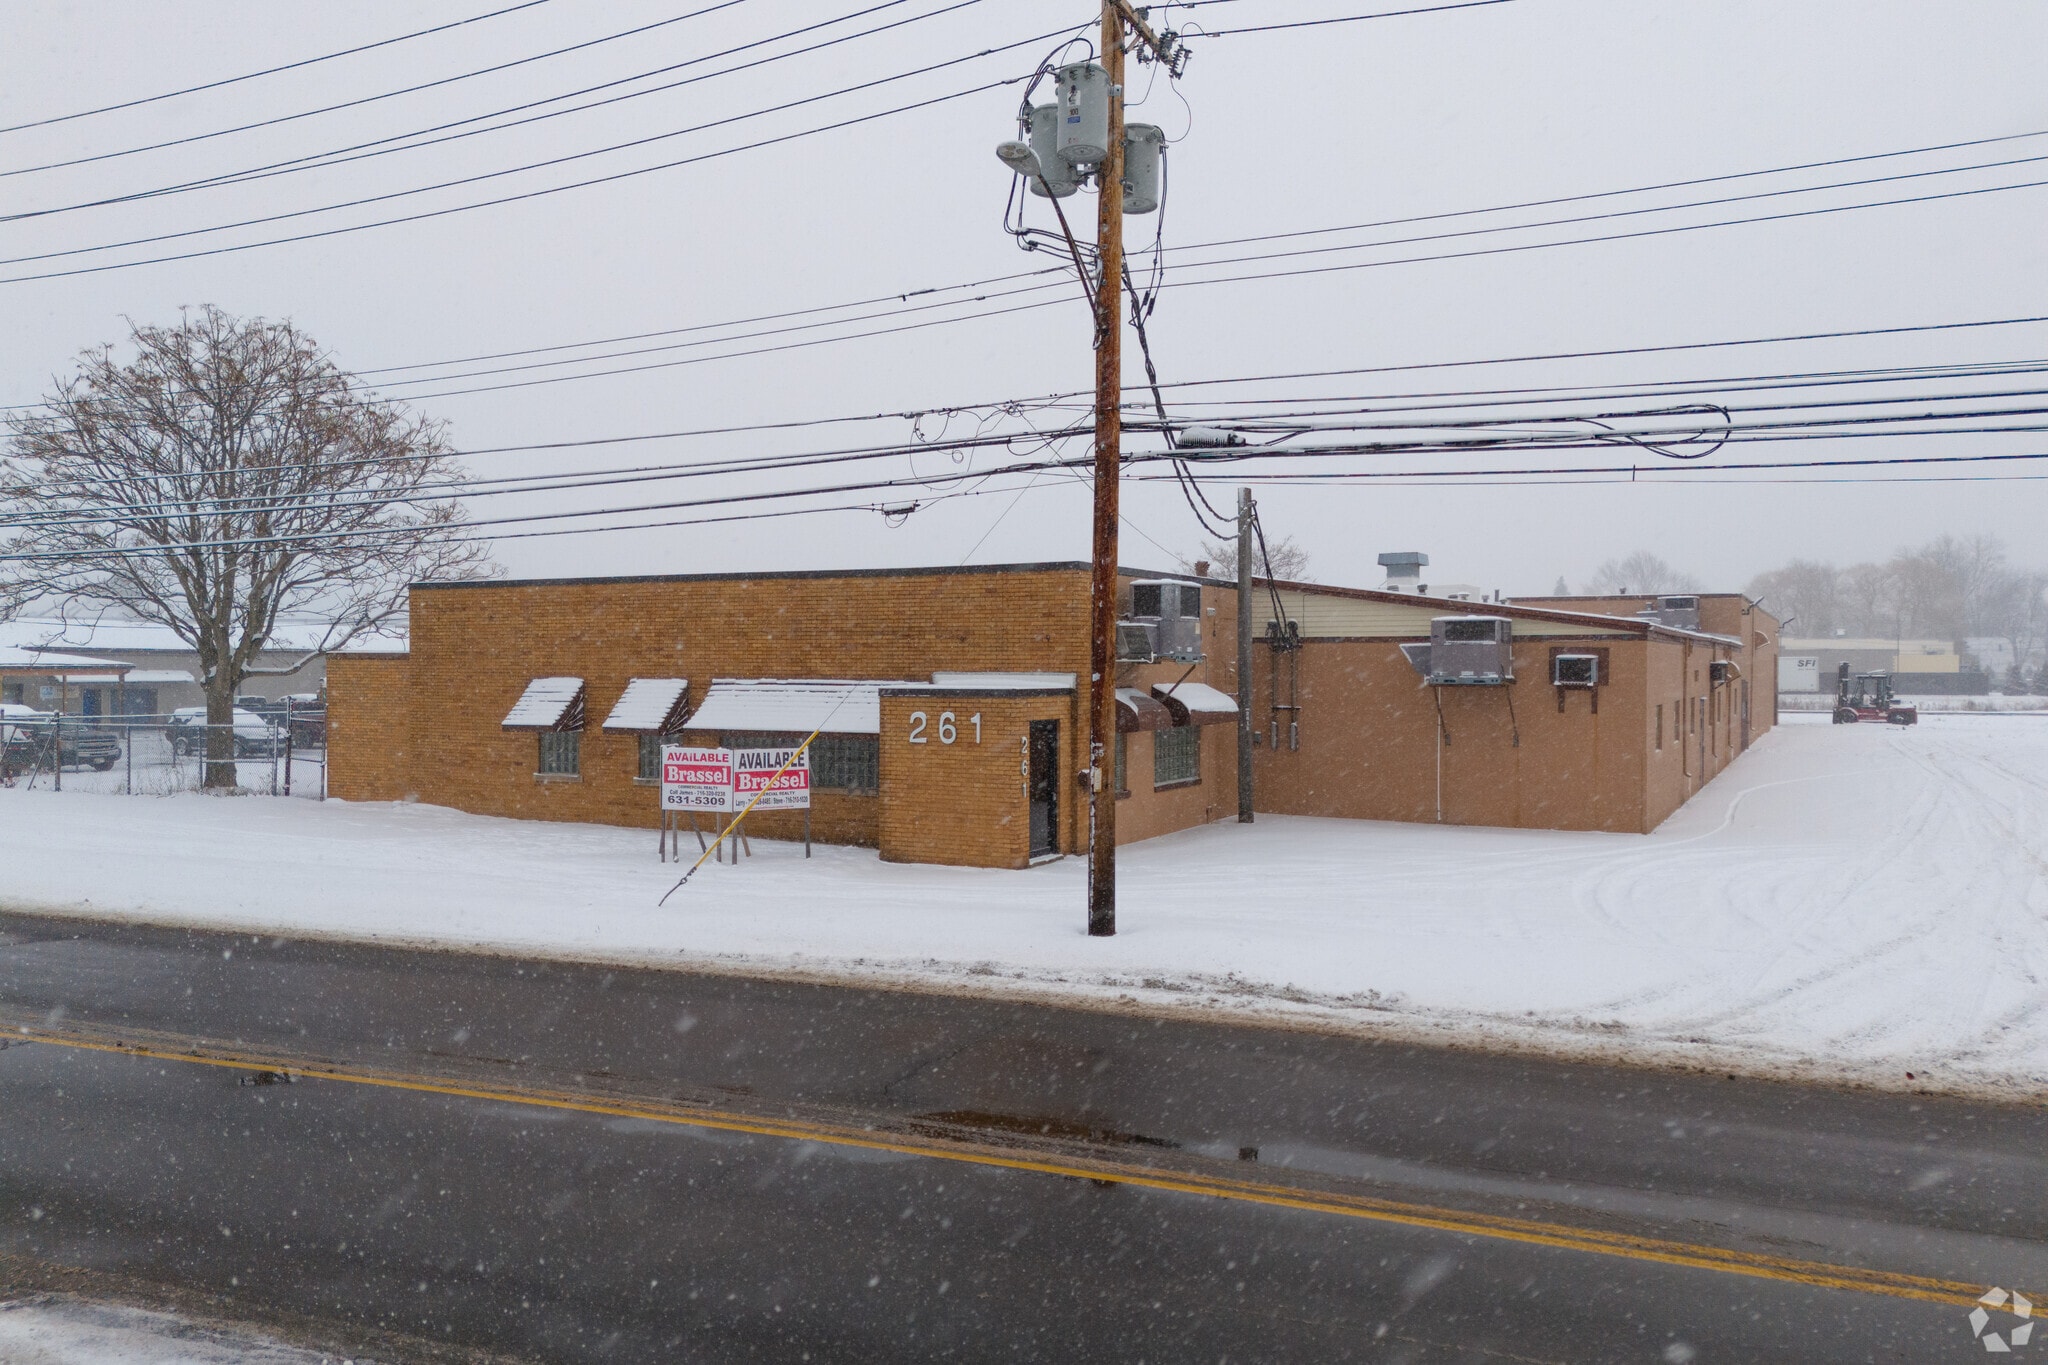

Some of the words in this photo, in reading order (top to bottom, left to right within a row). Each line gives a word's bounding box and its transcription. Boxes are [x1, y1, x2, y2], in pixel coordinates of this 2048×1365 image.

[1797, 659, 1816, 667] SFI
[909, 711, 981, 745] 261
[667, 752, 729, 762] AVAILABLE
[738, 751, 805, 769] AVAILABLE
[667, 765, 728, 783] Brassel
[1020, 736, 1028, 799] 261
[738, 771, 806, 790] Brassel
[668, 795, 726, 806] 631-5309
